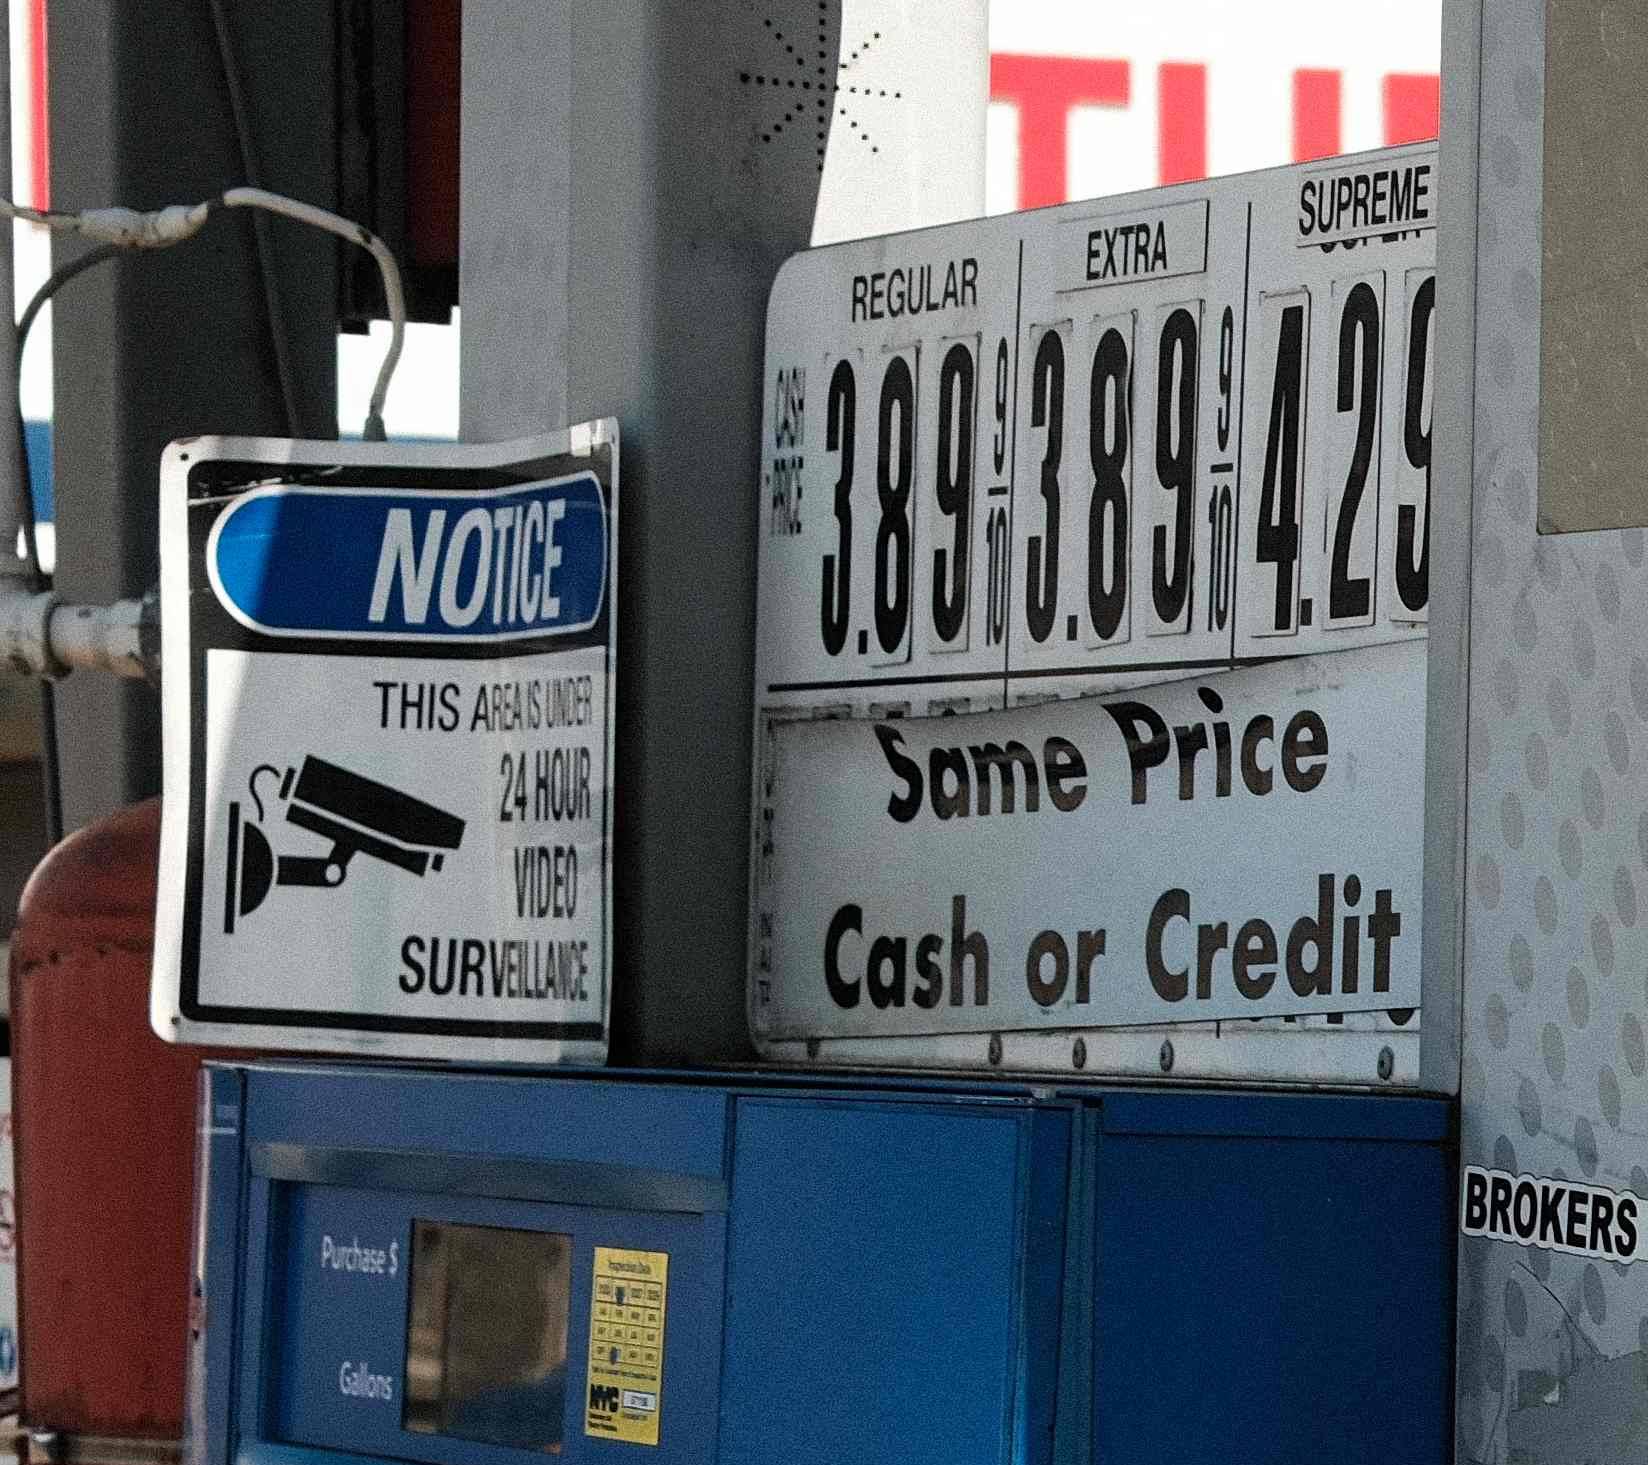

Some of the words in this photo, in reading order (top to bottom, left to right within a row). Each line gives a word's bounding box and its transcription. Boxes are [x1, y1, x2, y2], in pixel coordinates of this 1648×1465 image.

[1300, 166, 1430, 236] SUPREME
[1086, 222, 1168, 282] EXTRA
[852, 259, 978, 322] REGULAR
[367, 496, 564, 629] NOTICE
[373, 681, 460, 732] THIS
[470, 680, 522, 732] AREA
[527, 679, 542, 730] IS
[545, 675, 593, 728] UNDER
[500, 751, 528, 822] 24
[535, 746, 592, 821] HOUR
[875, 720, 1088, 823] Same
[1102, 687, 1329, 805] Price
[514, 845, 579, 919] VIDEO
[399, 934, 589, 1001] SURVEILLANCE
[824, 895, 989, 1008] Cash
[1026, 923, 1104, 1006] or
[1145, 873, 1402, 1004] Credit
[1465, 1171, 1637, 1257] BROKERS
[321, 1235, 385, 1274] Purchase
[339, 1361, 393, 1401] Gallons
[589, 1383, 620, 1414] NYC
